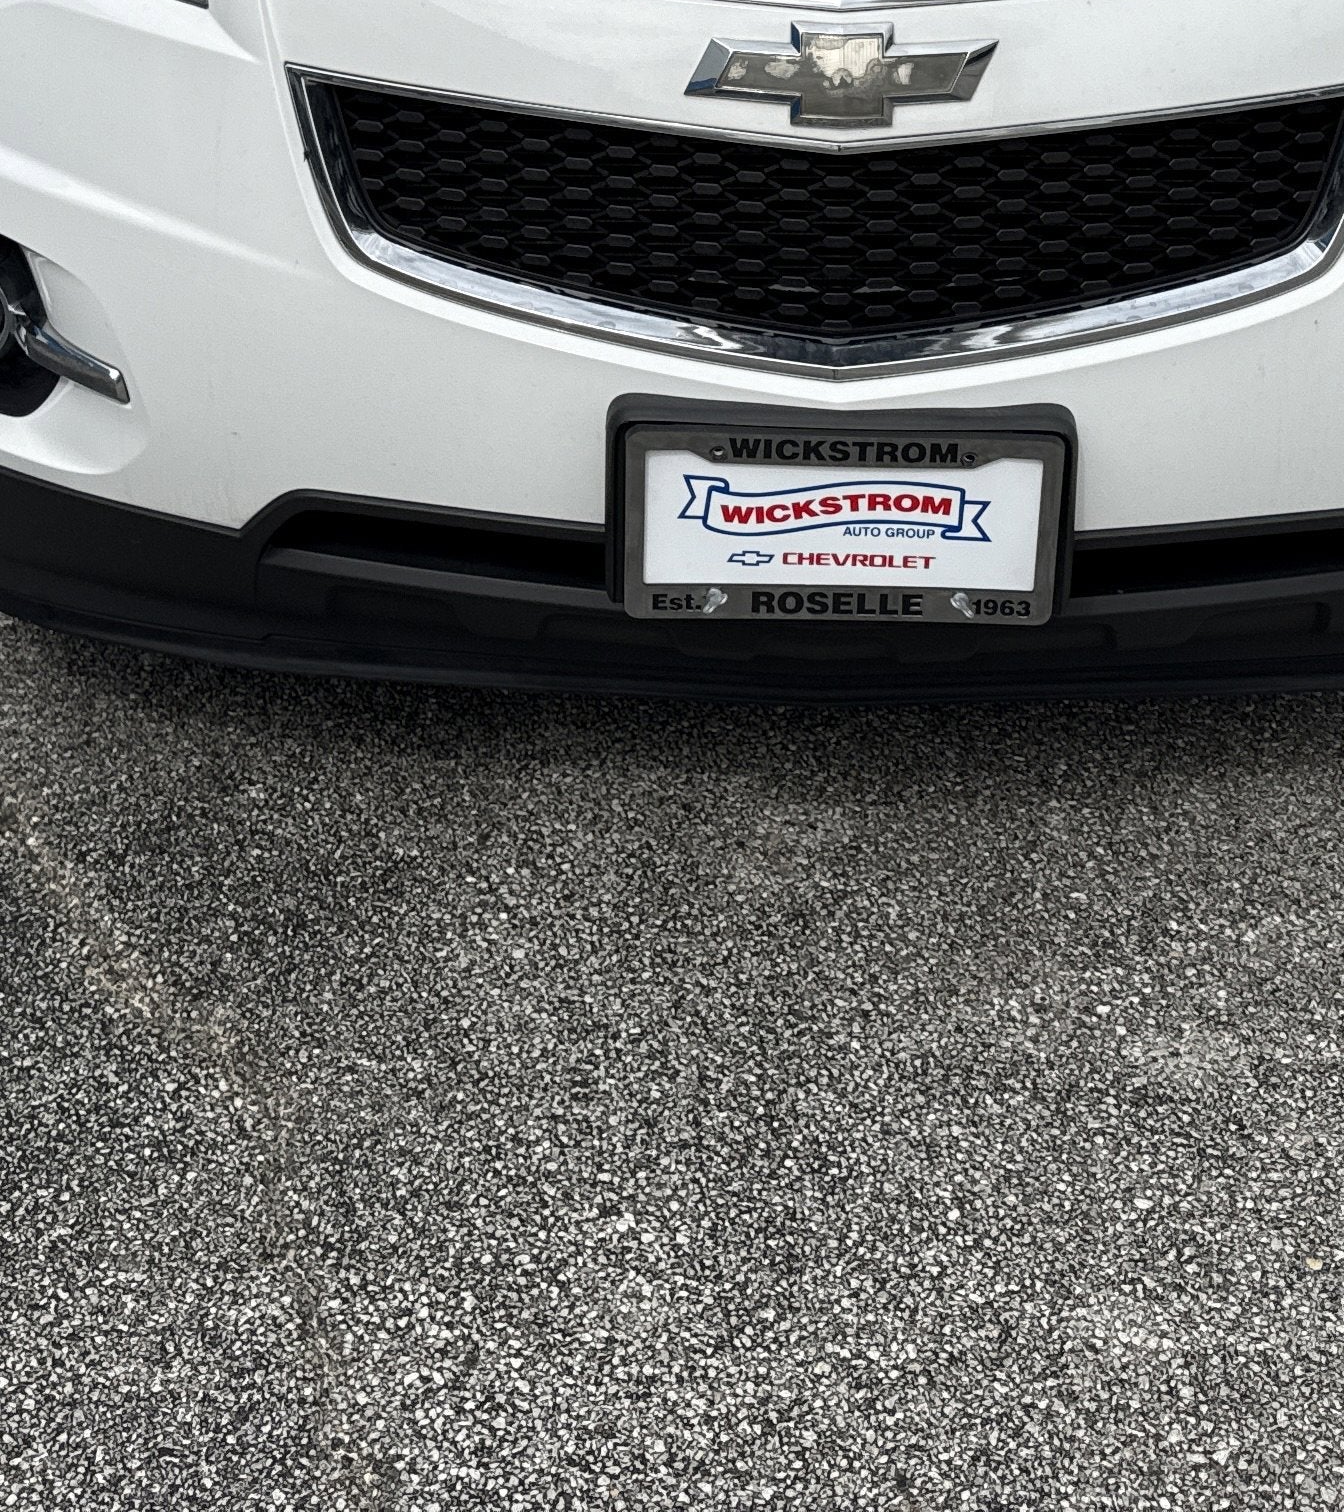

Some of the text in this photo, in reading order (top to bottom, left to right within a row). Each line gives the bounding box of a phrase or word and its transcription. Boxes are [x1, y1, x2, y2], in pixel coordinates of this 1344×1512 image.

[729, 437, 960, 464] WICKSTROM
[721, 493, 953, 525] WICKSTROM
[842, 526, 936, 540] AUTO GROUP
[781, 552, 936, 570] CHEVROLET
[652, 591, 1032, 617] Est. ROSELLE 1963
